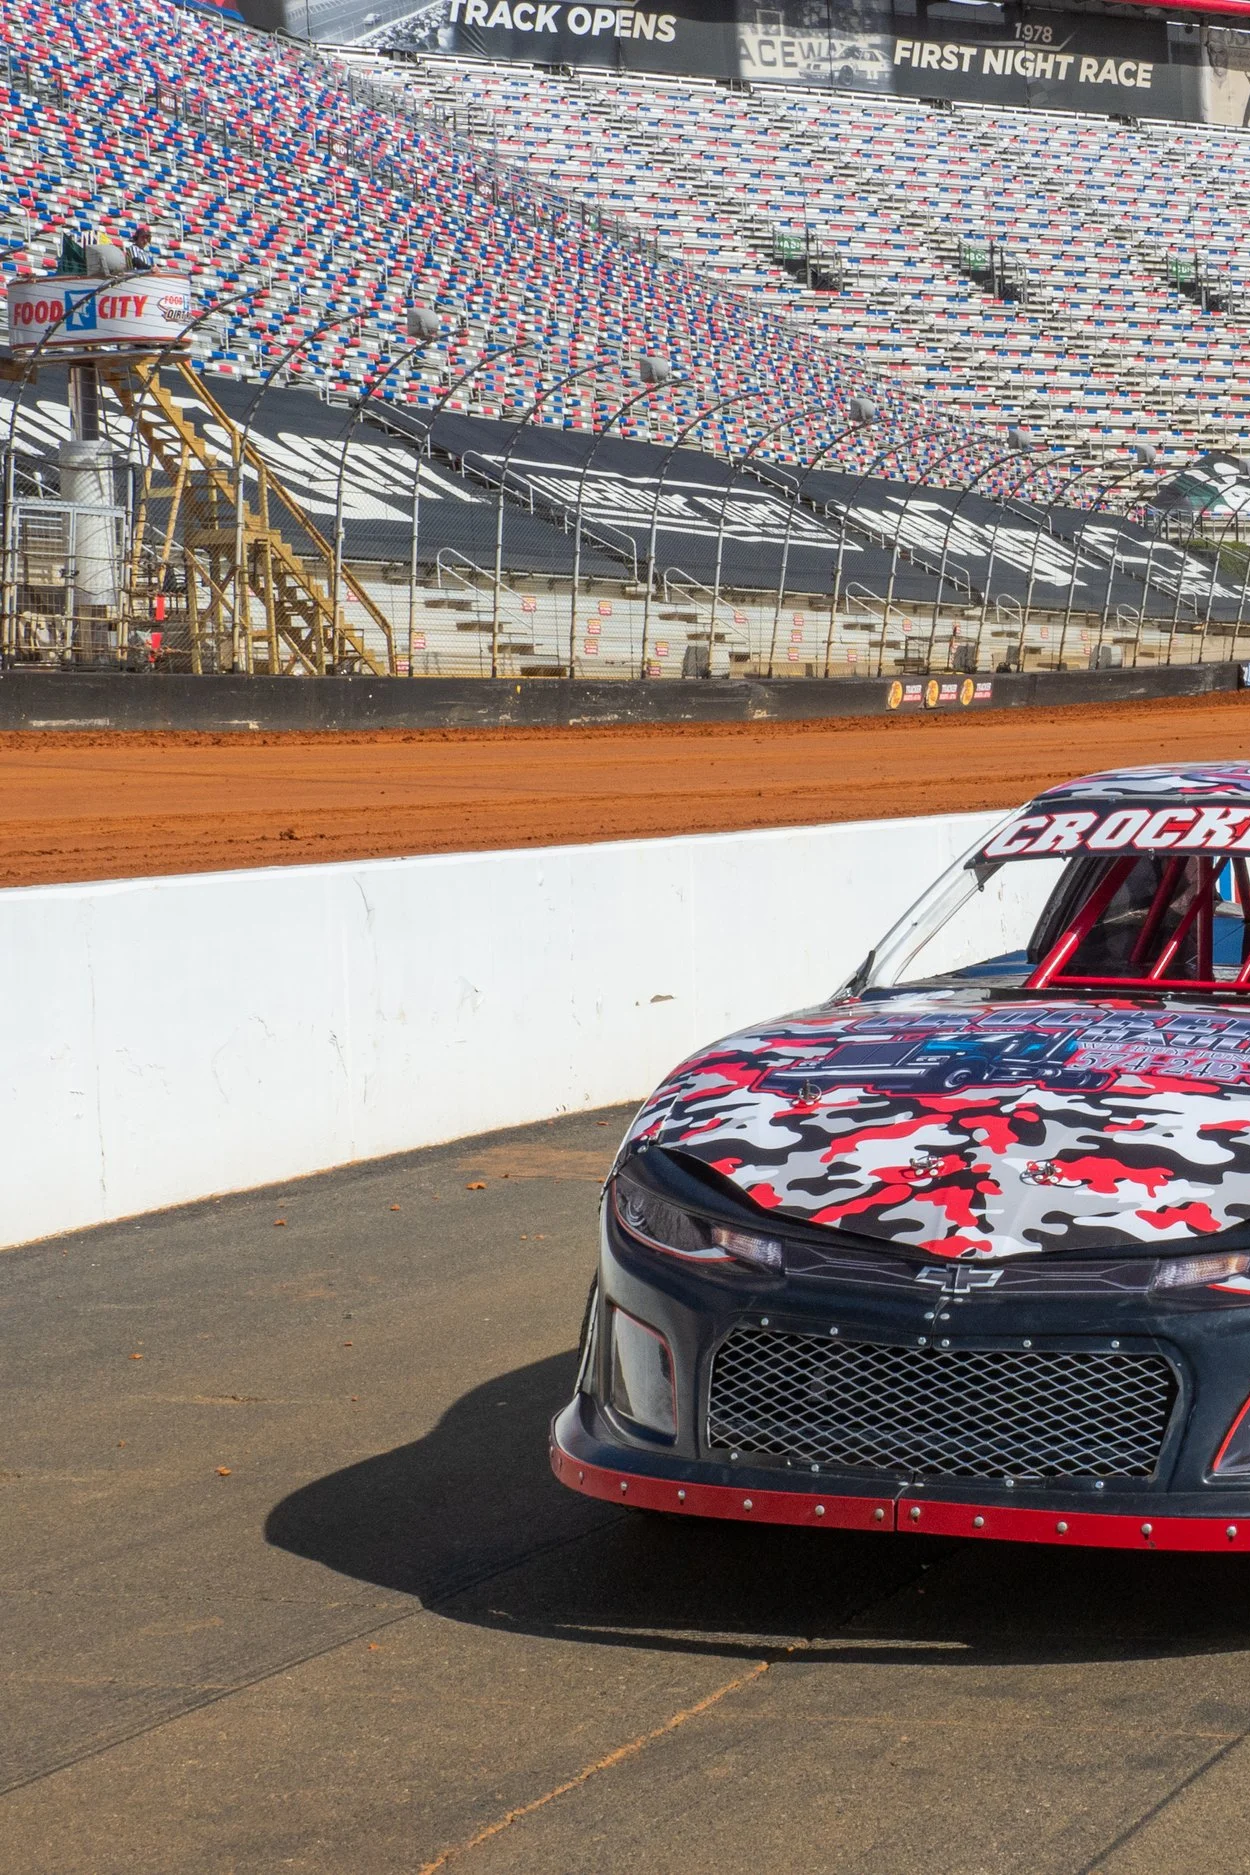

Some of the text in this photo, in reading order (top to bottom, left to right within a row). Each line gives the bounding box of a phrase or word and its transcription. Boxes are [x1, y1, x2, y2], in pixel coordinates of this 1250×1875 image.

[449, 0, 677, 43] TRACK OPENS
[1014, 22, 1053, 43] 1978
[894, 40, 1154, 88] FIRST NIGHT RACE
[14, 295, 148, 326] FOOD CITY
